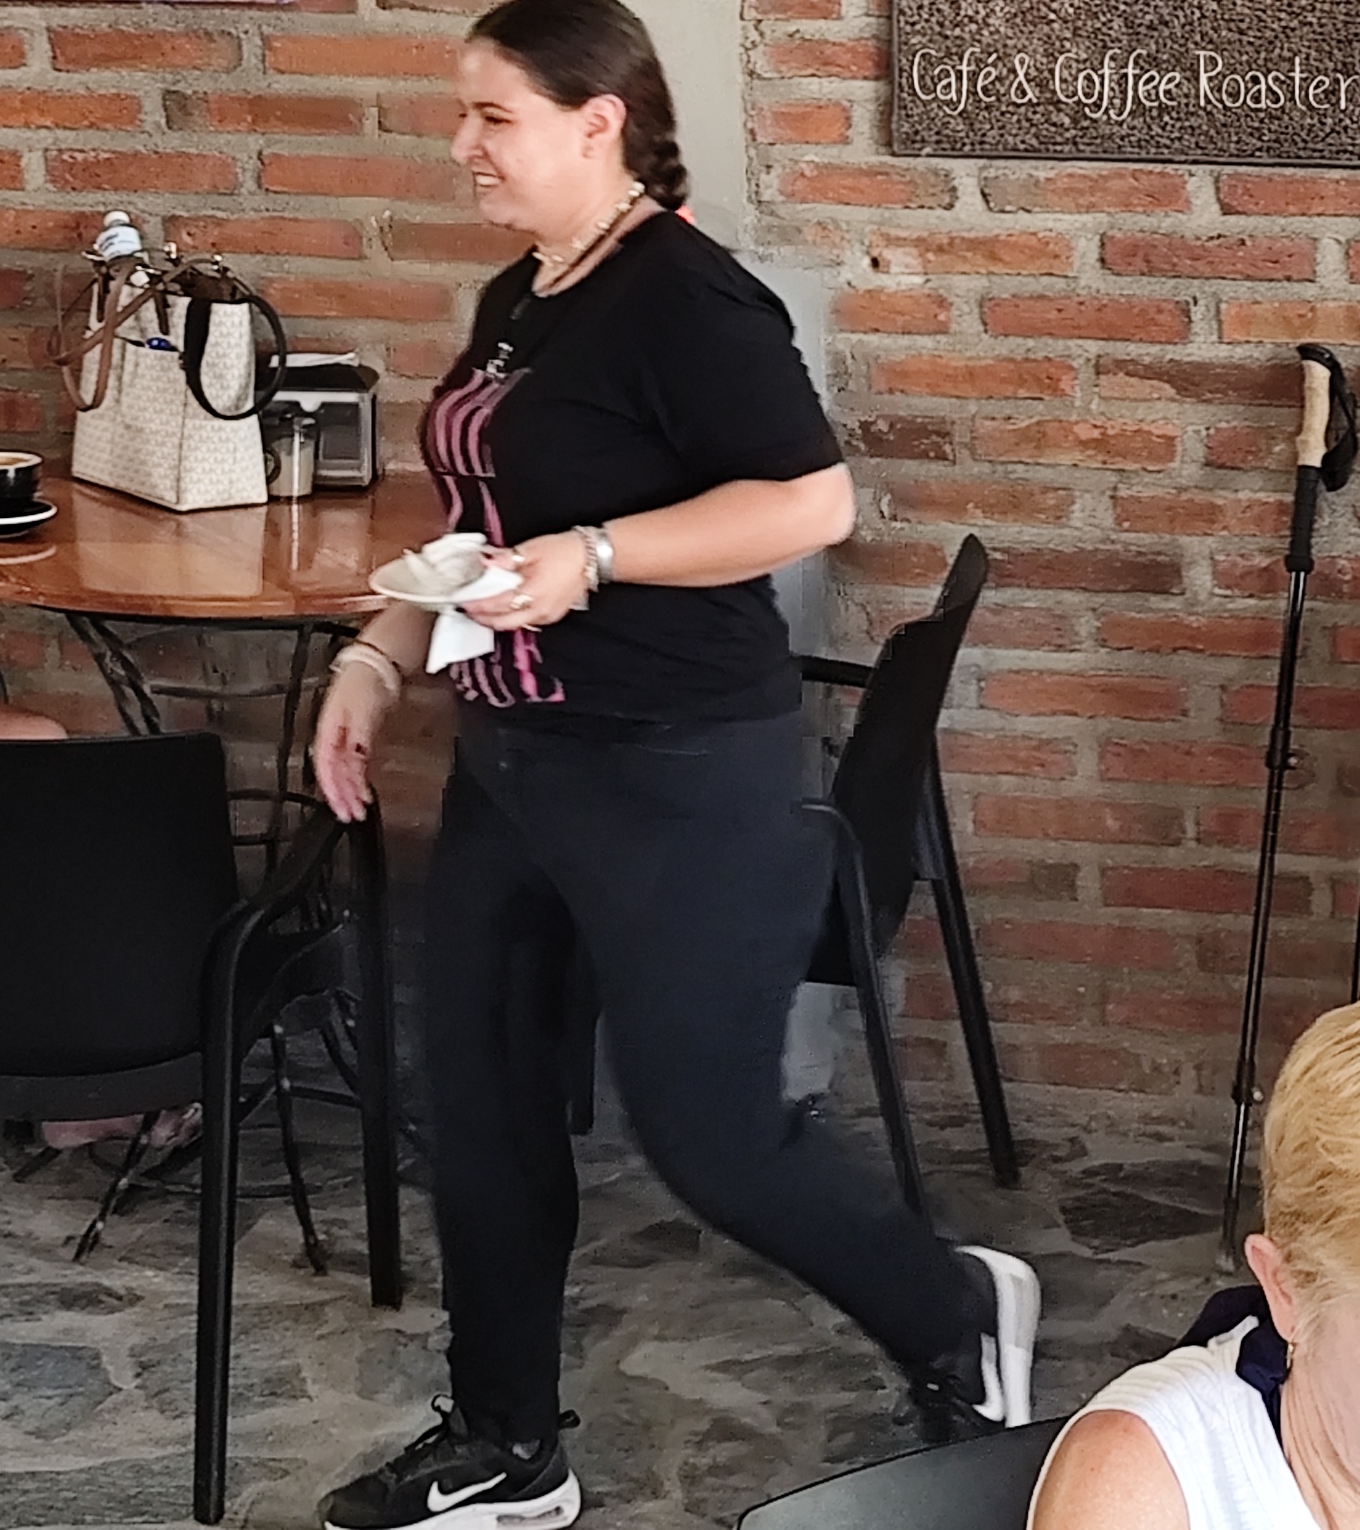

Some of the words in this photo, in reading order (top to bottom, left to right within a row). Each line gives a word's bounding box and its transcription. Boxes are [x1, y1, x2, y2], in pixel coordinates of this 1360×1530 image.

[912, 46, 998, 116] Café
[1009, 52, 1039, 104] &
[1054, 48, 1182, 121] Coffee
[1195, 49, 1360, 111] Roaster
